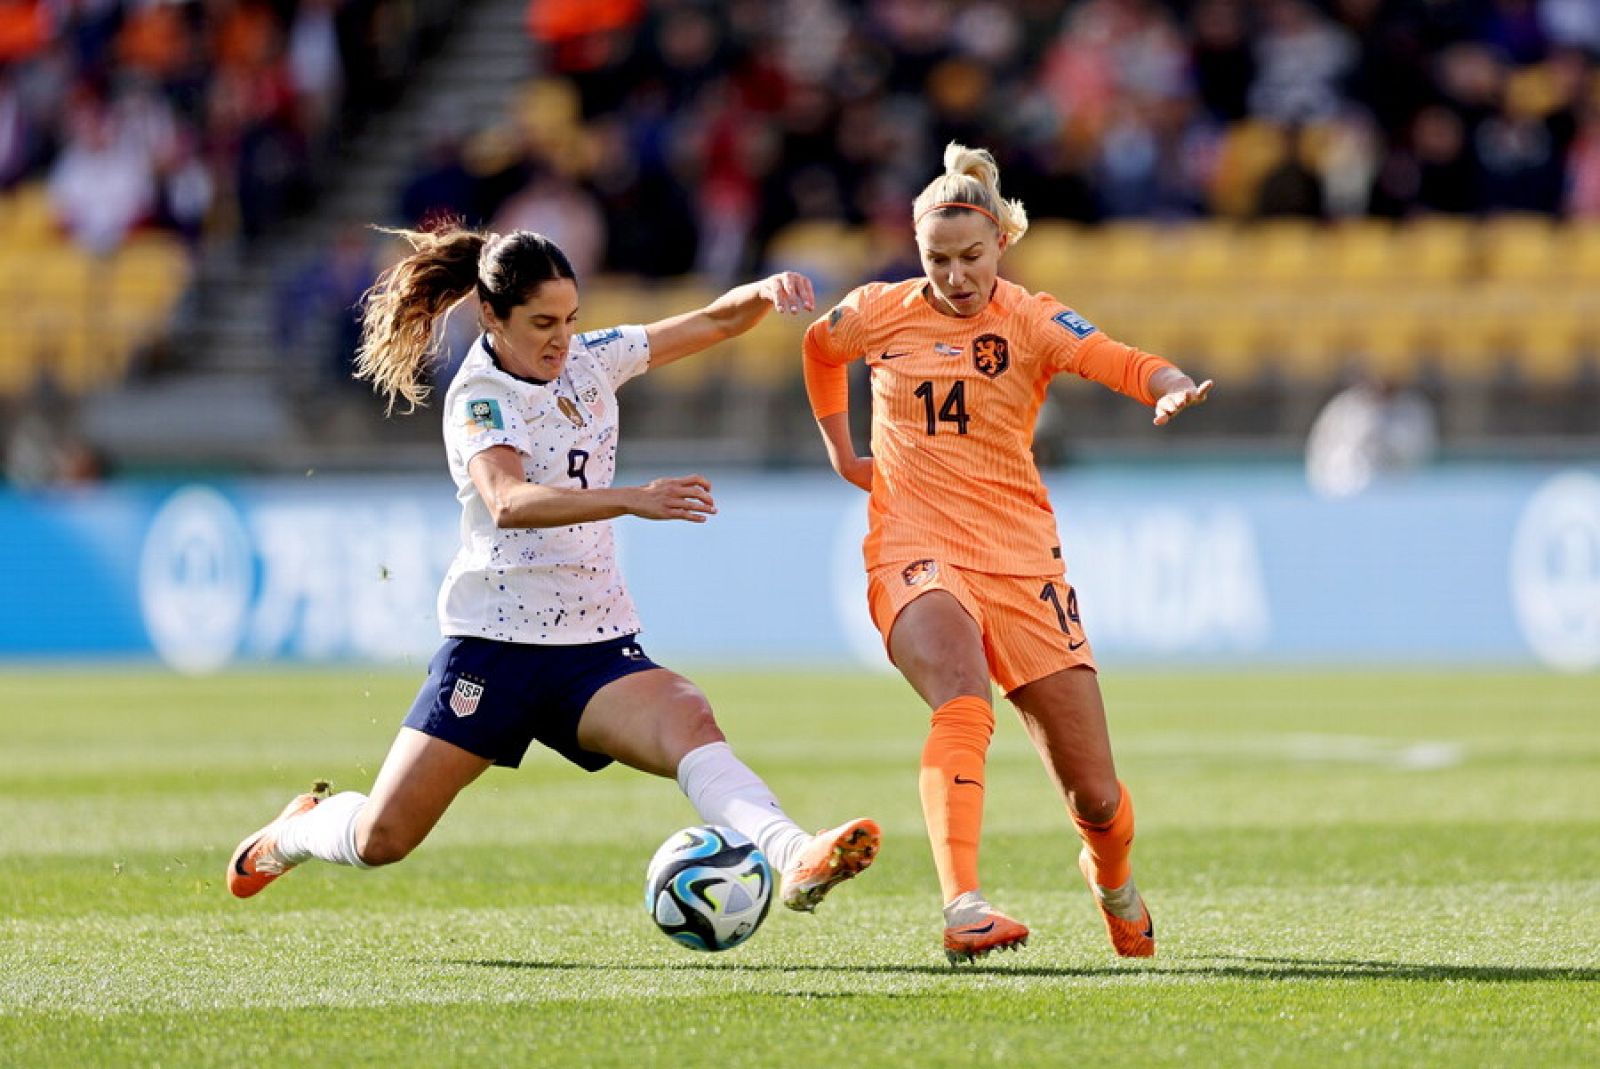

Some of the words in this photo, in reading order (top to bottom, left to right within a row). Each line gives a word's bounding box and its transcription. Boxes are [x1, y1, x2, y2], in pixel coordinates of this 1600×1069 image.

[913, 380, 971, 437] 14
[567, 448, 589, 490] 9
[455, 680, 483, 699] USA
